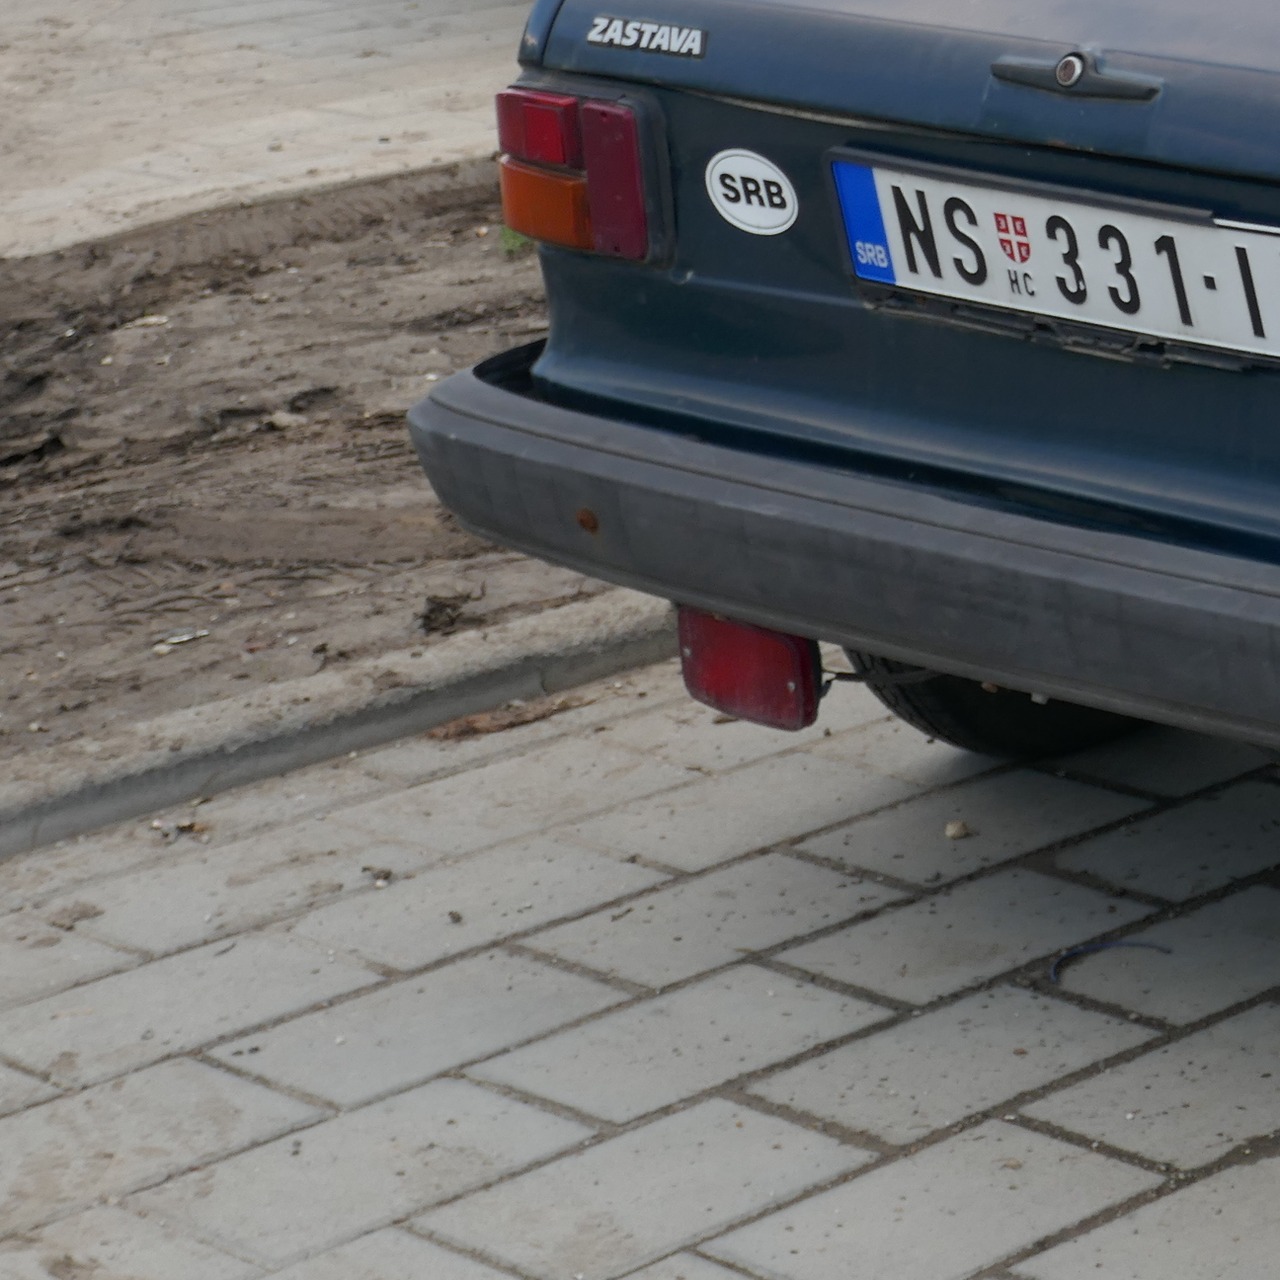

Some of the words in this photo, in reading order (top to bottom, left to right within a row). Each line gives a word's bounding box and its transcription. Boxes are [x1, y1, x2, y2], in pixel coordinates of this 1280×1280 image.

[587, 17, 702, 55] ZASTAVA
[719, 173, 787, 210] SRB
[891, 185, 987, 286] NS
[855, 241, 888, 268] SRB
